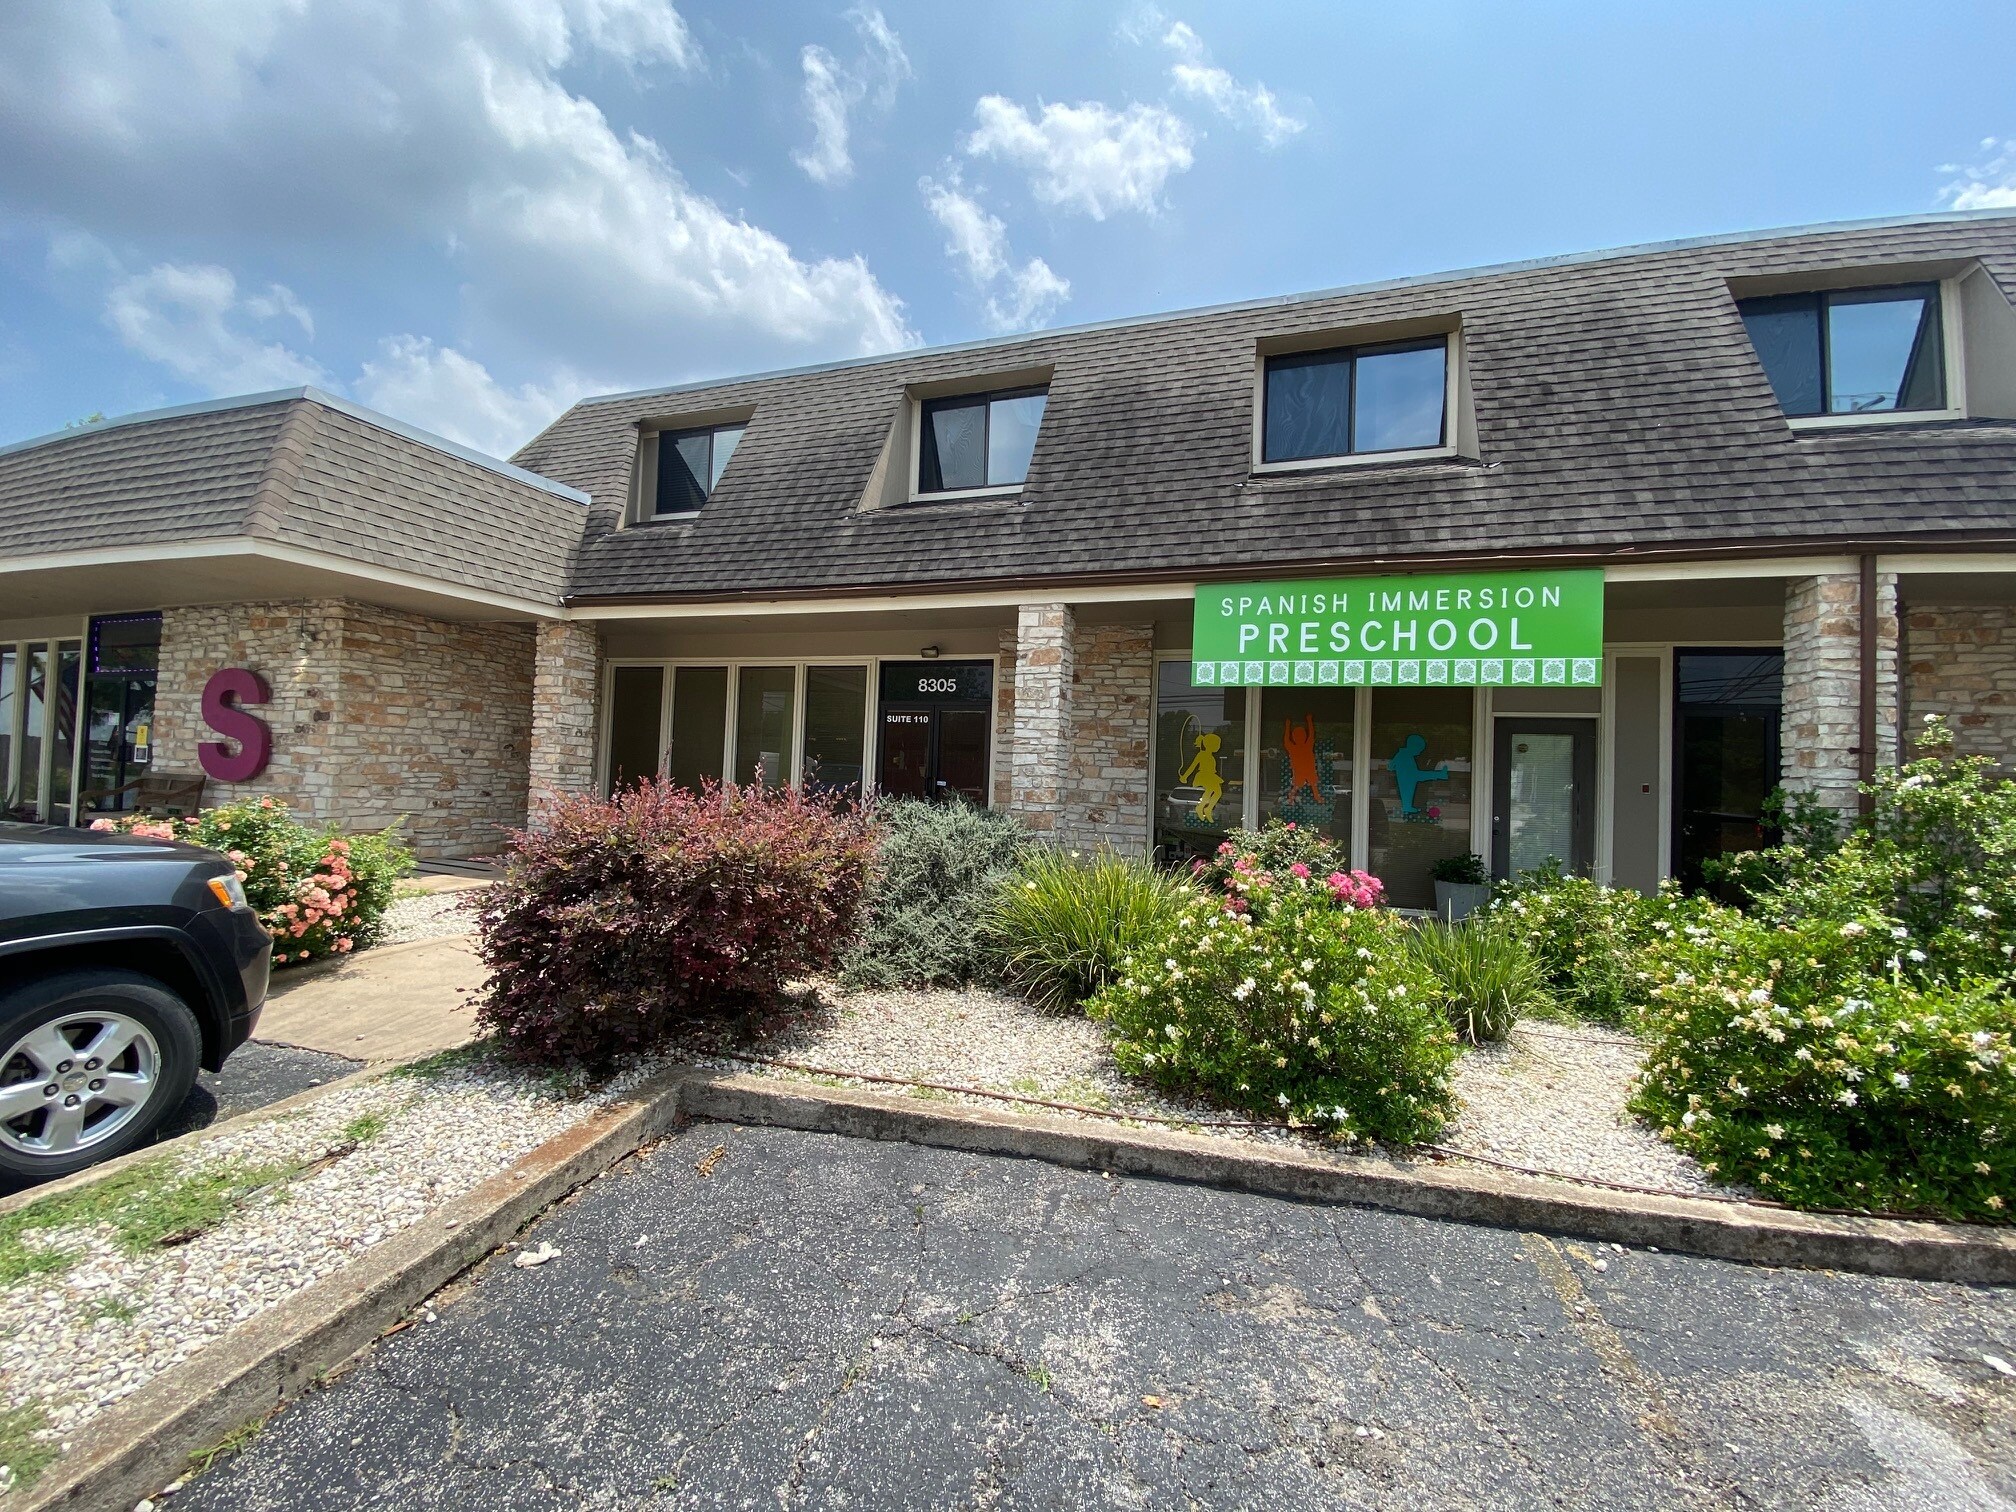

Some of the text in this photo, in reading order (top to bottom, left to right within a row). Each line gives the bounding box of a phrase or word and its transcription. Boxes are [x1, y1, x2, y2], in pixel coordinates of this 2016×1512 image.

[1220, 586, 1560, 617] SPANISH IMMERSION
[1239, 617, 1533, 654] PRESCHOOL
[918, 678, 956, 692] 8305
[198, 668, 271, 783] S
[886, 715, 929, 724] SUITE 110
